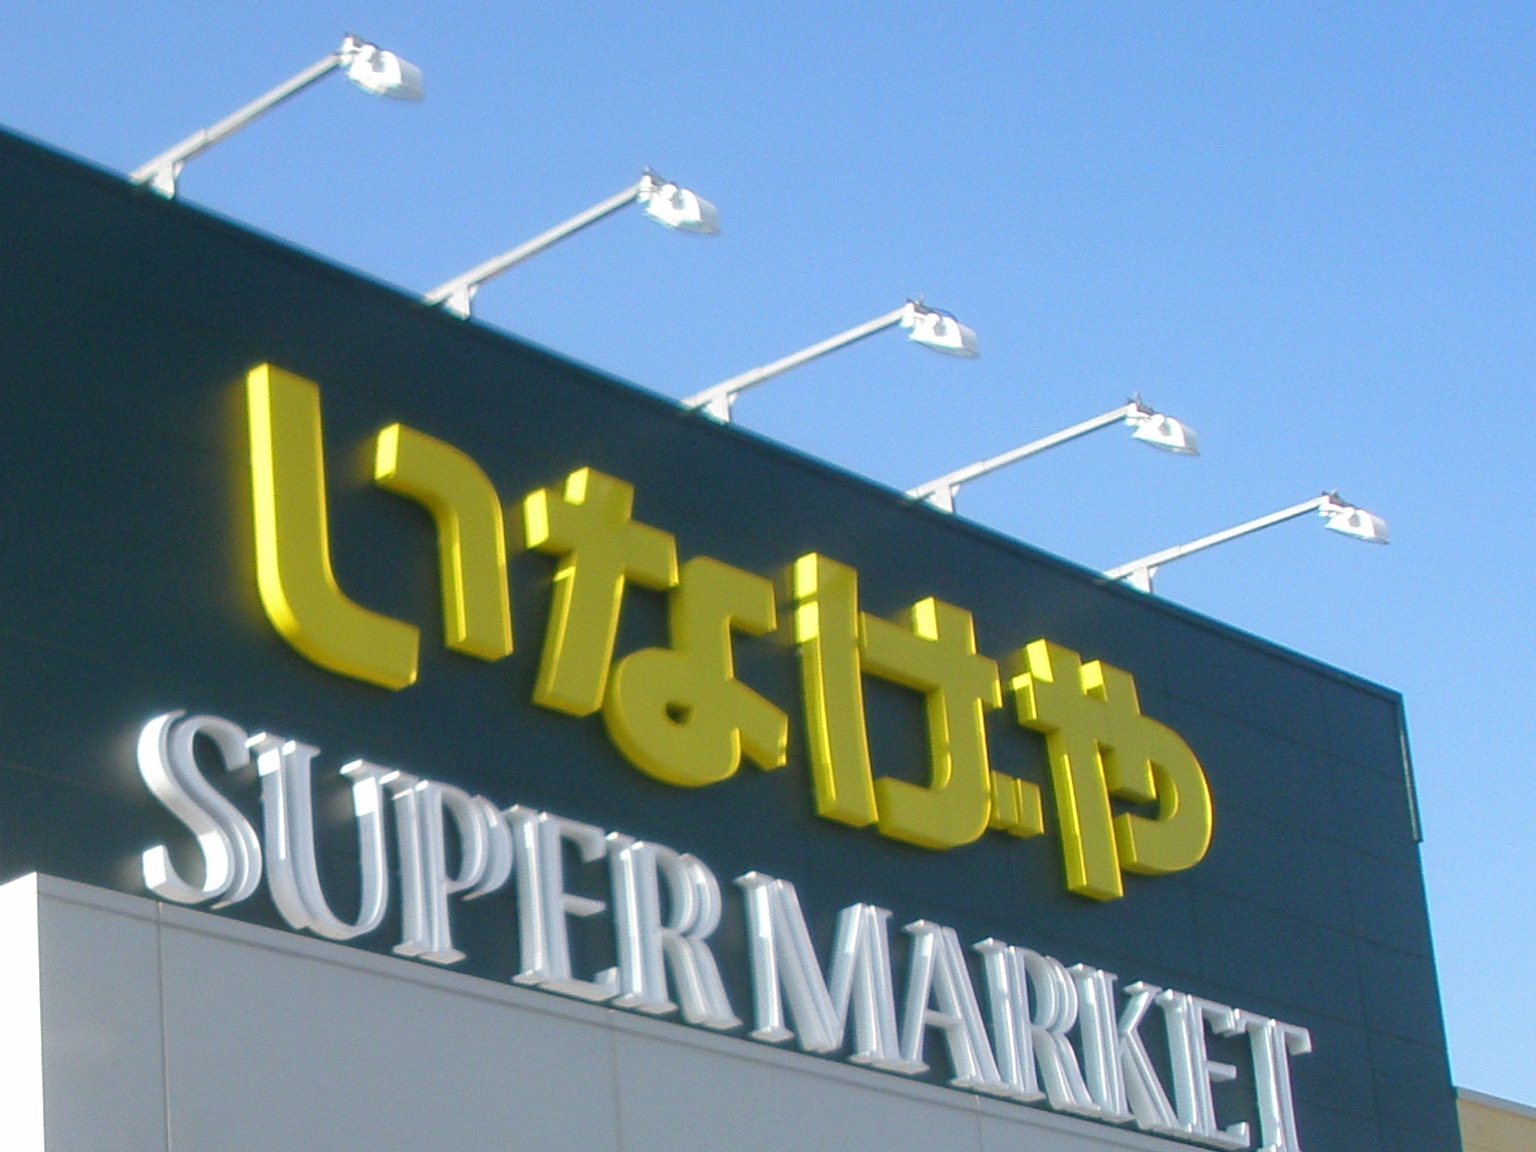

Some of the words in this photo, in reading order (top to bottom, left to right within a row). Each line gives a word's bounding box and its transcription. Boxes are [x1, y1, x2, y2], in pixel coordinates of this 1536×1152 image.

[247, 362, 1214, 901] いなげや
[136, 708, 743, 1032] SUPER
